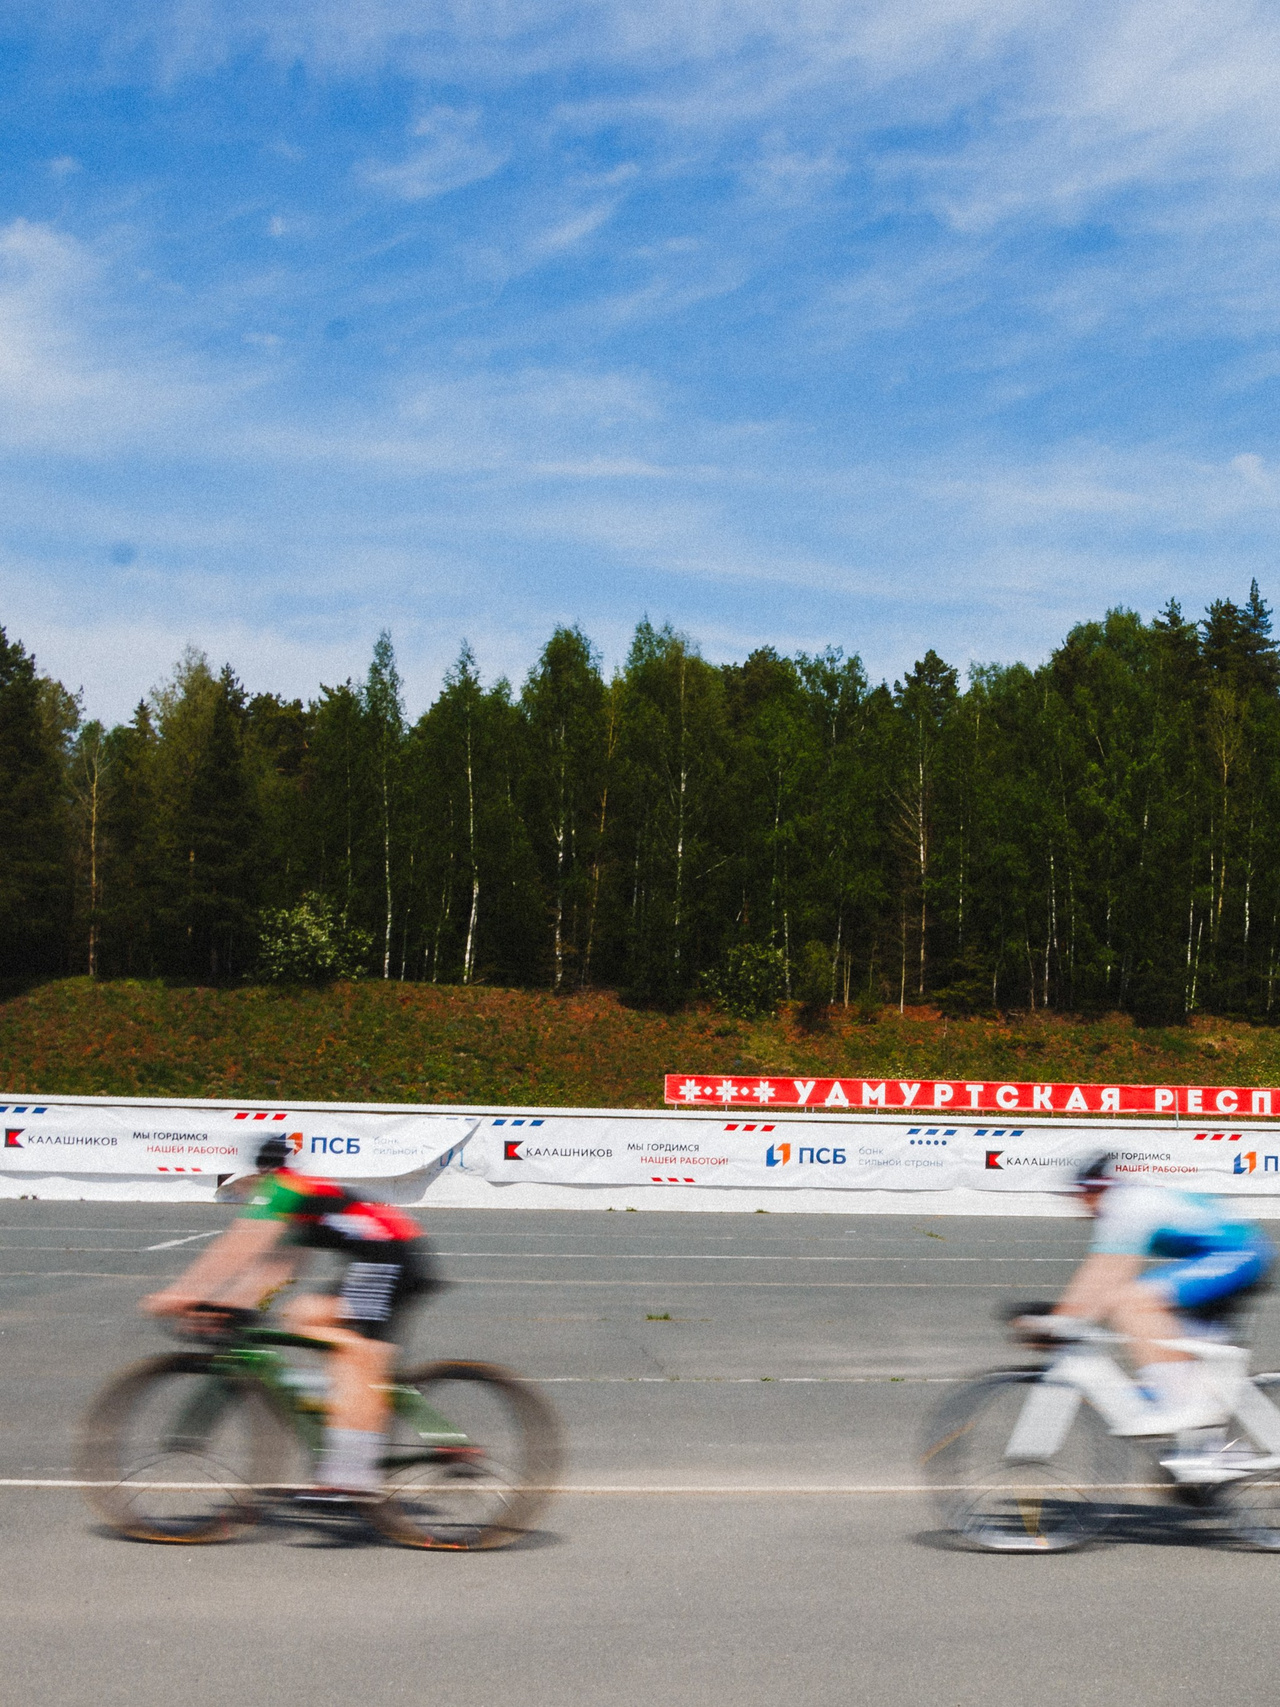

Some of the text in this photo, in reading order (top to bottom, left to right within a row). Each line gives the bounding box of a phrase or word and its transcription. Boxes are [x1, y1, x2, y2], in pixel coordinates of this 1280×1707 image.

[793, 1080, 1121, 1111] УДМУРТСКАЯ
[28, 1135, 118, 1147] КАЛАШНИКОВ
[133, 1131, 209, 1142] МЫ ГОРДИМСЯ
[147, 1144, 239, 1155] НАШЕЙ РАБОТОЙ!
[311, 1136, 361, 1155] ПСБ
[627, 1142, 700, 1153] МЫ ГОРДИМСЯ
[859, 1146, 884, 1155] банк
[525, 1146, 613, 1158] КАЛАШНИКОВ
[799, 1147, 847, 1164] ПСБ
[1121, 1152, 1171, 1161] ГОРДИМСЯ
[640, 1154, 729, 1165] НАШЕЙ РАБОТОЙ!
[859, 1157, 944, 1169] сильной страны
[1006, 1157, 1086, 1167] КАЛАШНИКО
[1115, 1163, 1150, 1173] НАШЕЙ
